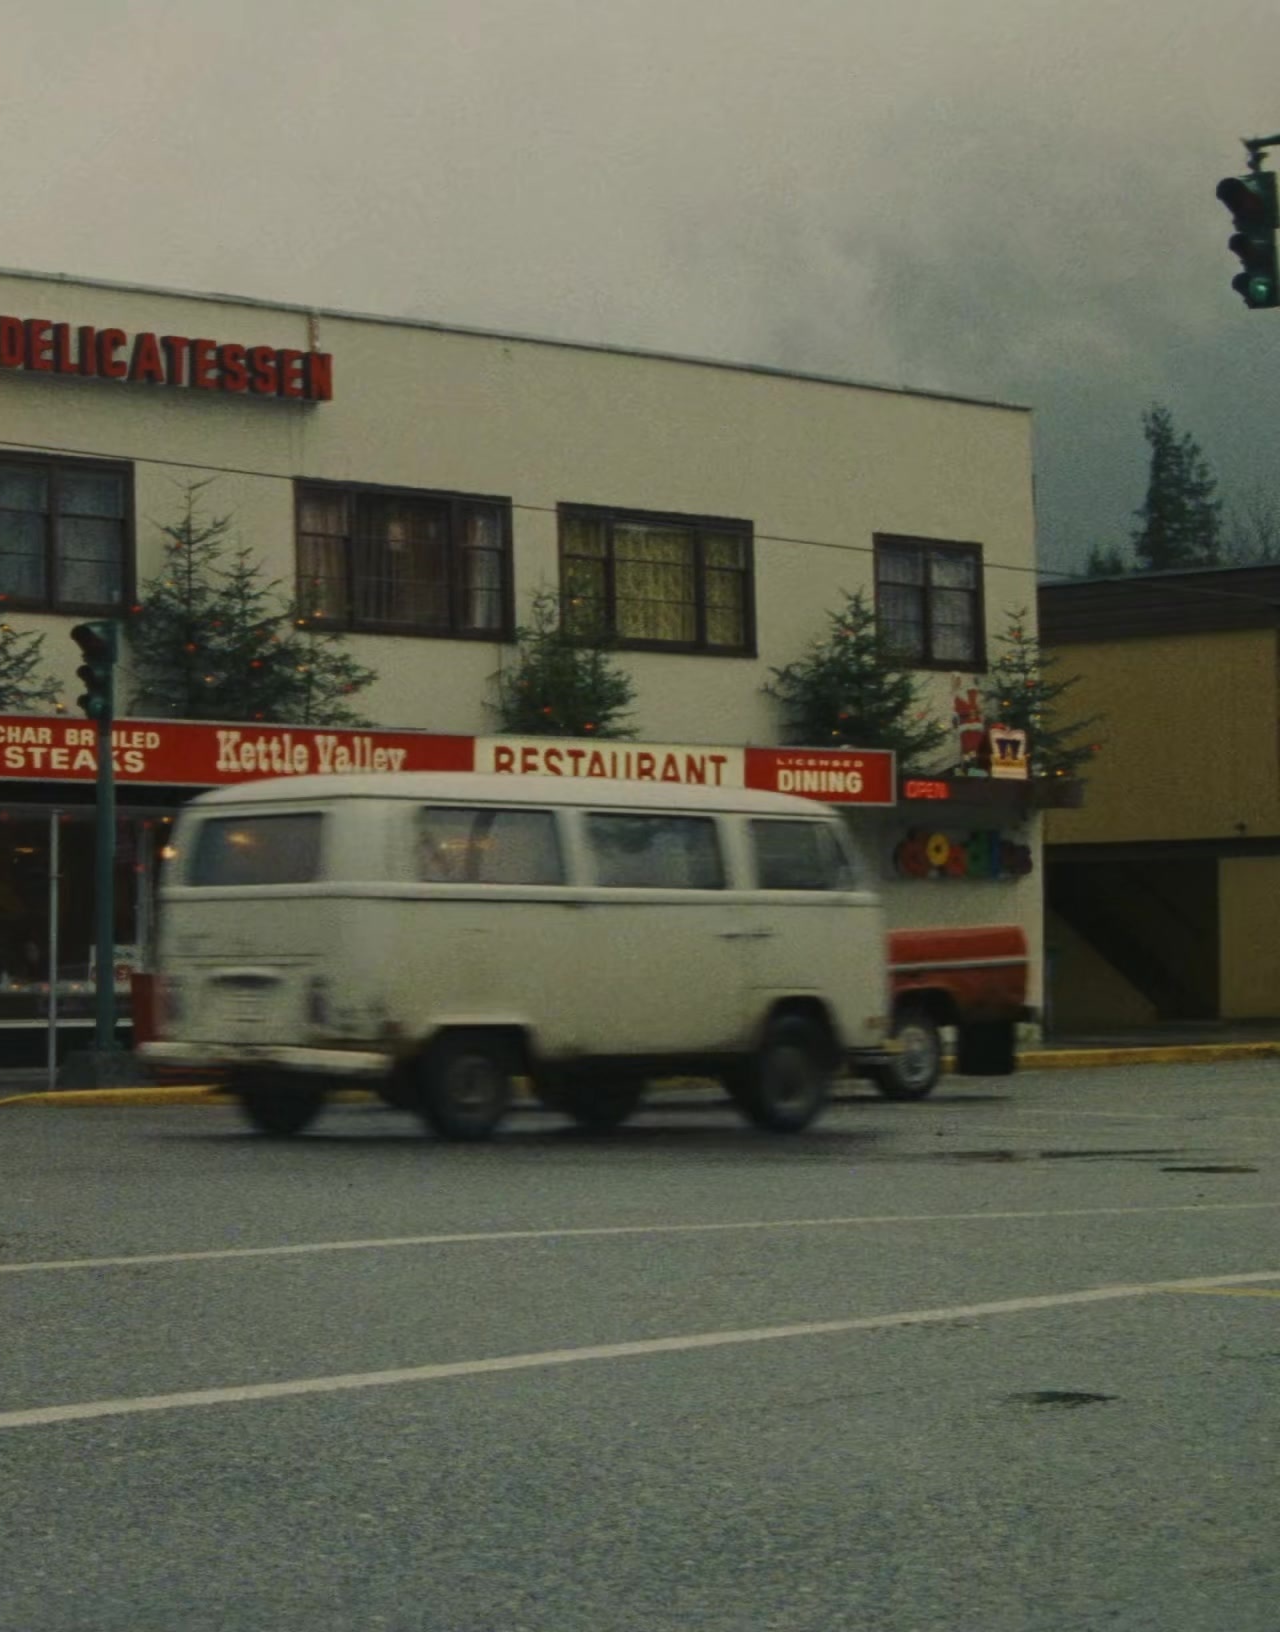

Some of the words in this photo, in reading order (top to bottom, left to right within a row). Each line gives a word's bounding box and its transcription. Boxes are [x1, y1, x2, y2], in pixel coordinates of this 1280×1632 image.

[65, 728, 160, 749] BRILED
[216, 730, 309, 773] Kettle
[314, 735, 406, 773] Valley
[776, 758, 864, 768] LICENSED
[493, 745, 728, 786] RESTAURANT
[777, 769, 863, 793] DINING
